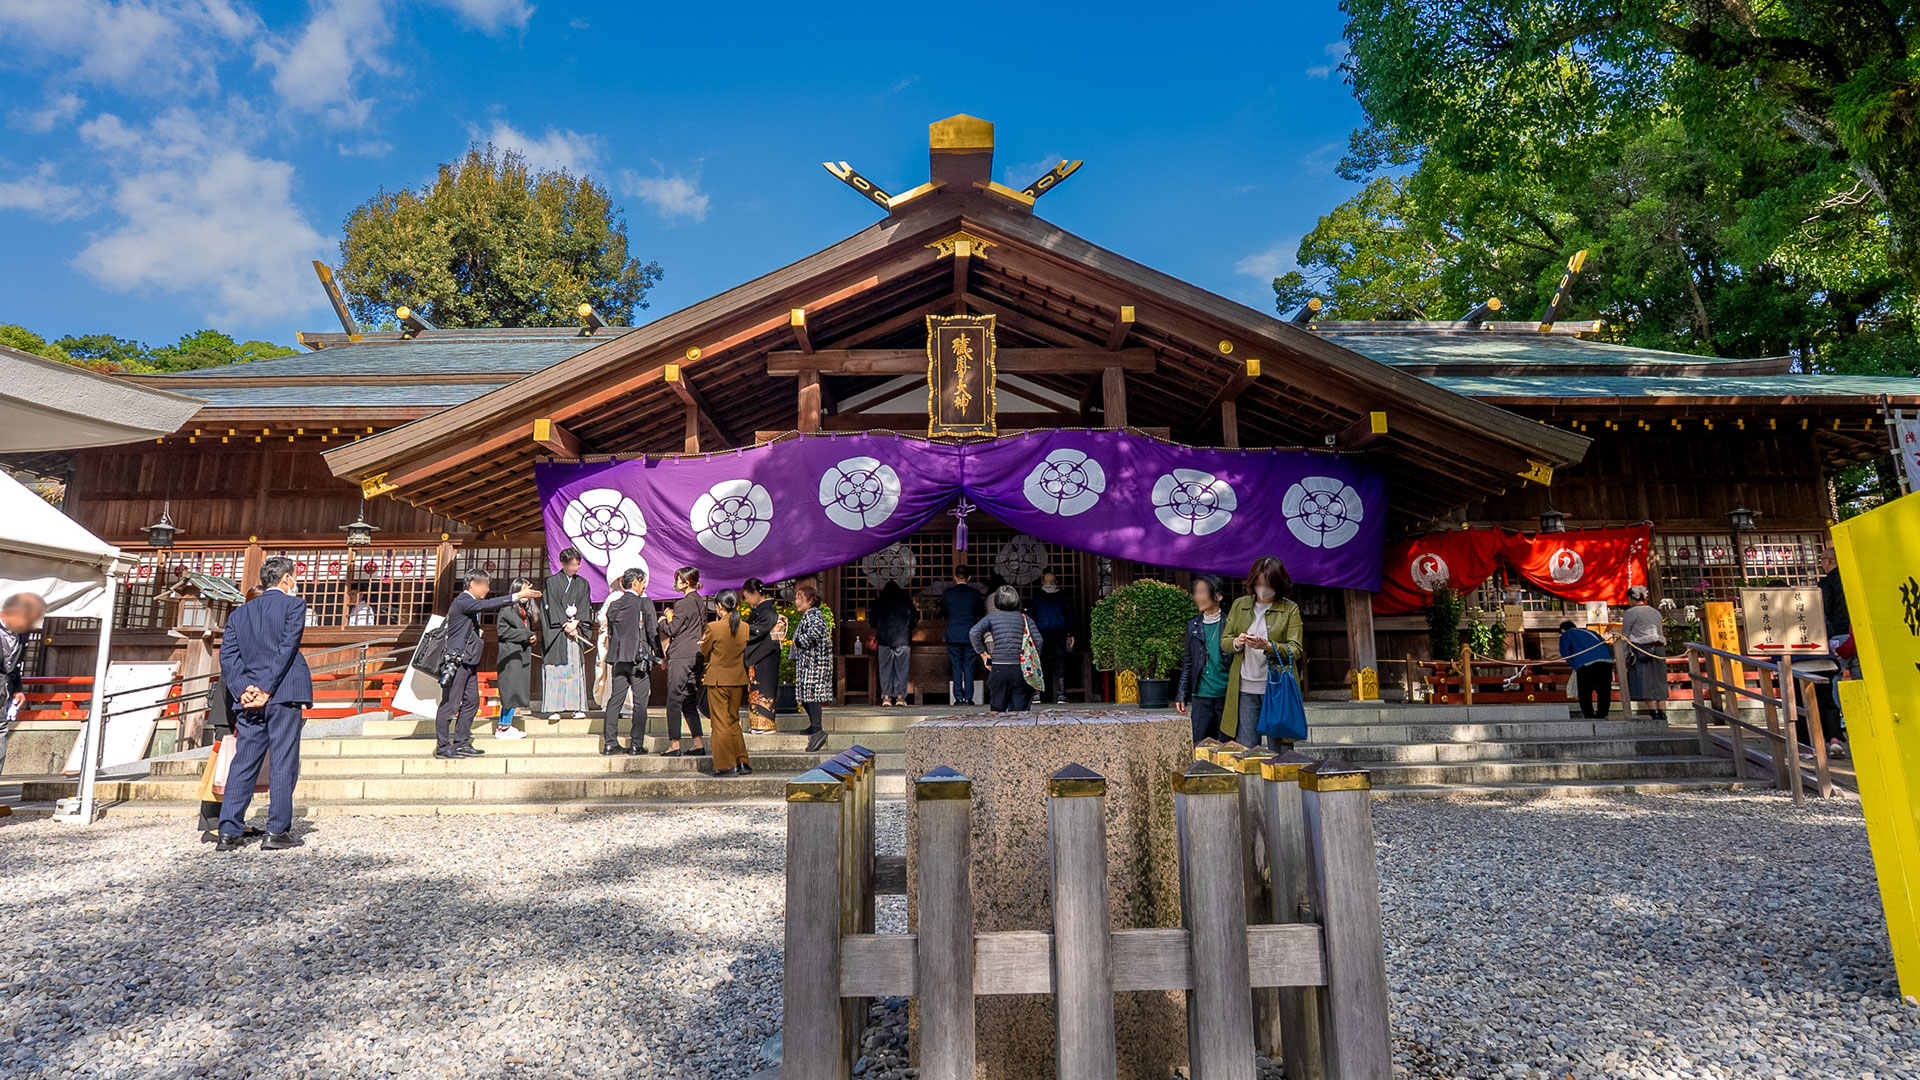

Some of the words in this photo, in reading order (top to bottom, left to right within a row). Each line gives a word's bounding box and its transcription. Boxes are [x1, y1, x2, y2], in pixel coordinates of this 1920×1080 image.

[1759, 592, 1774, 644] 猿田彦神社
[1794, 592, 1809, 644] 佐瑠女神社
